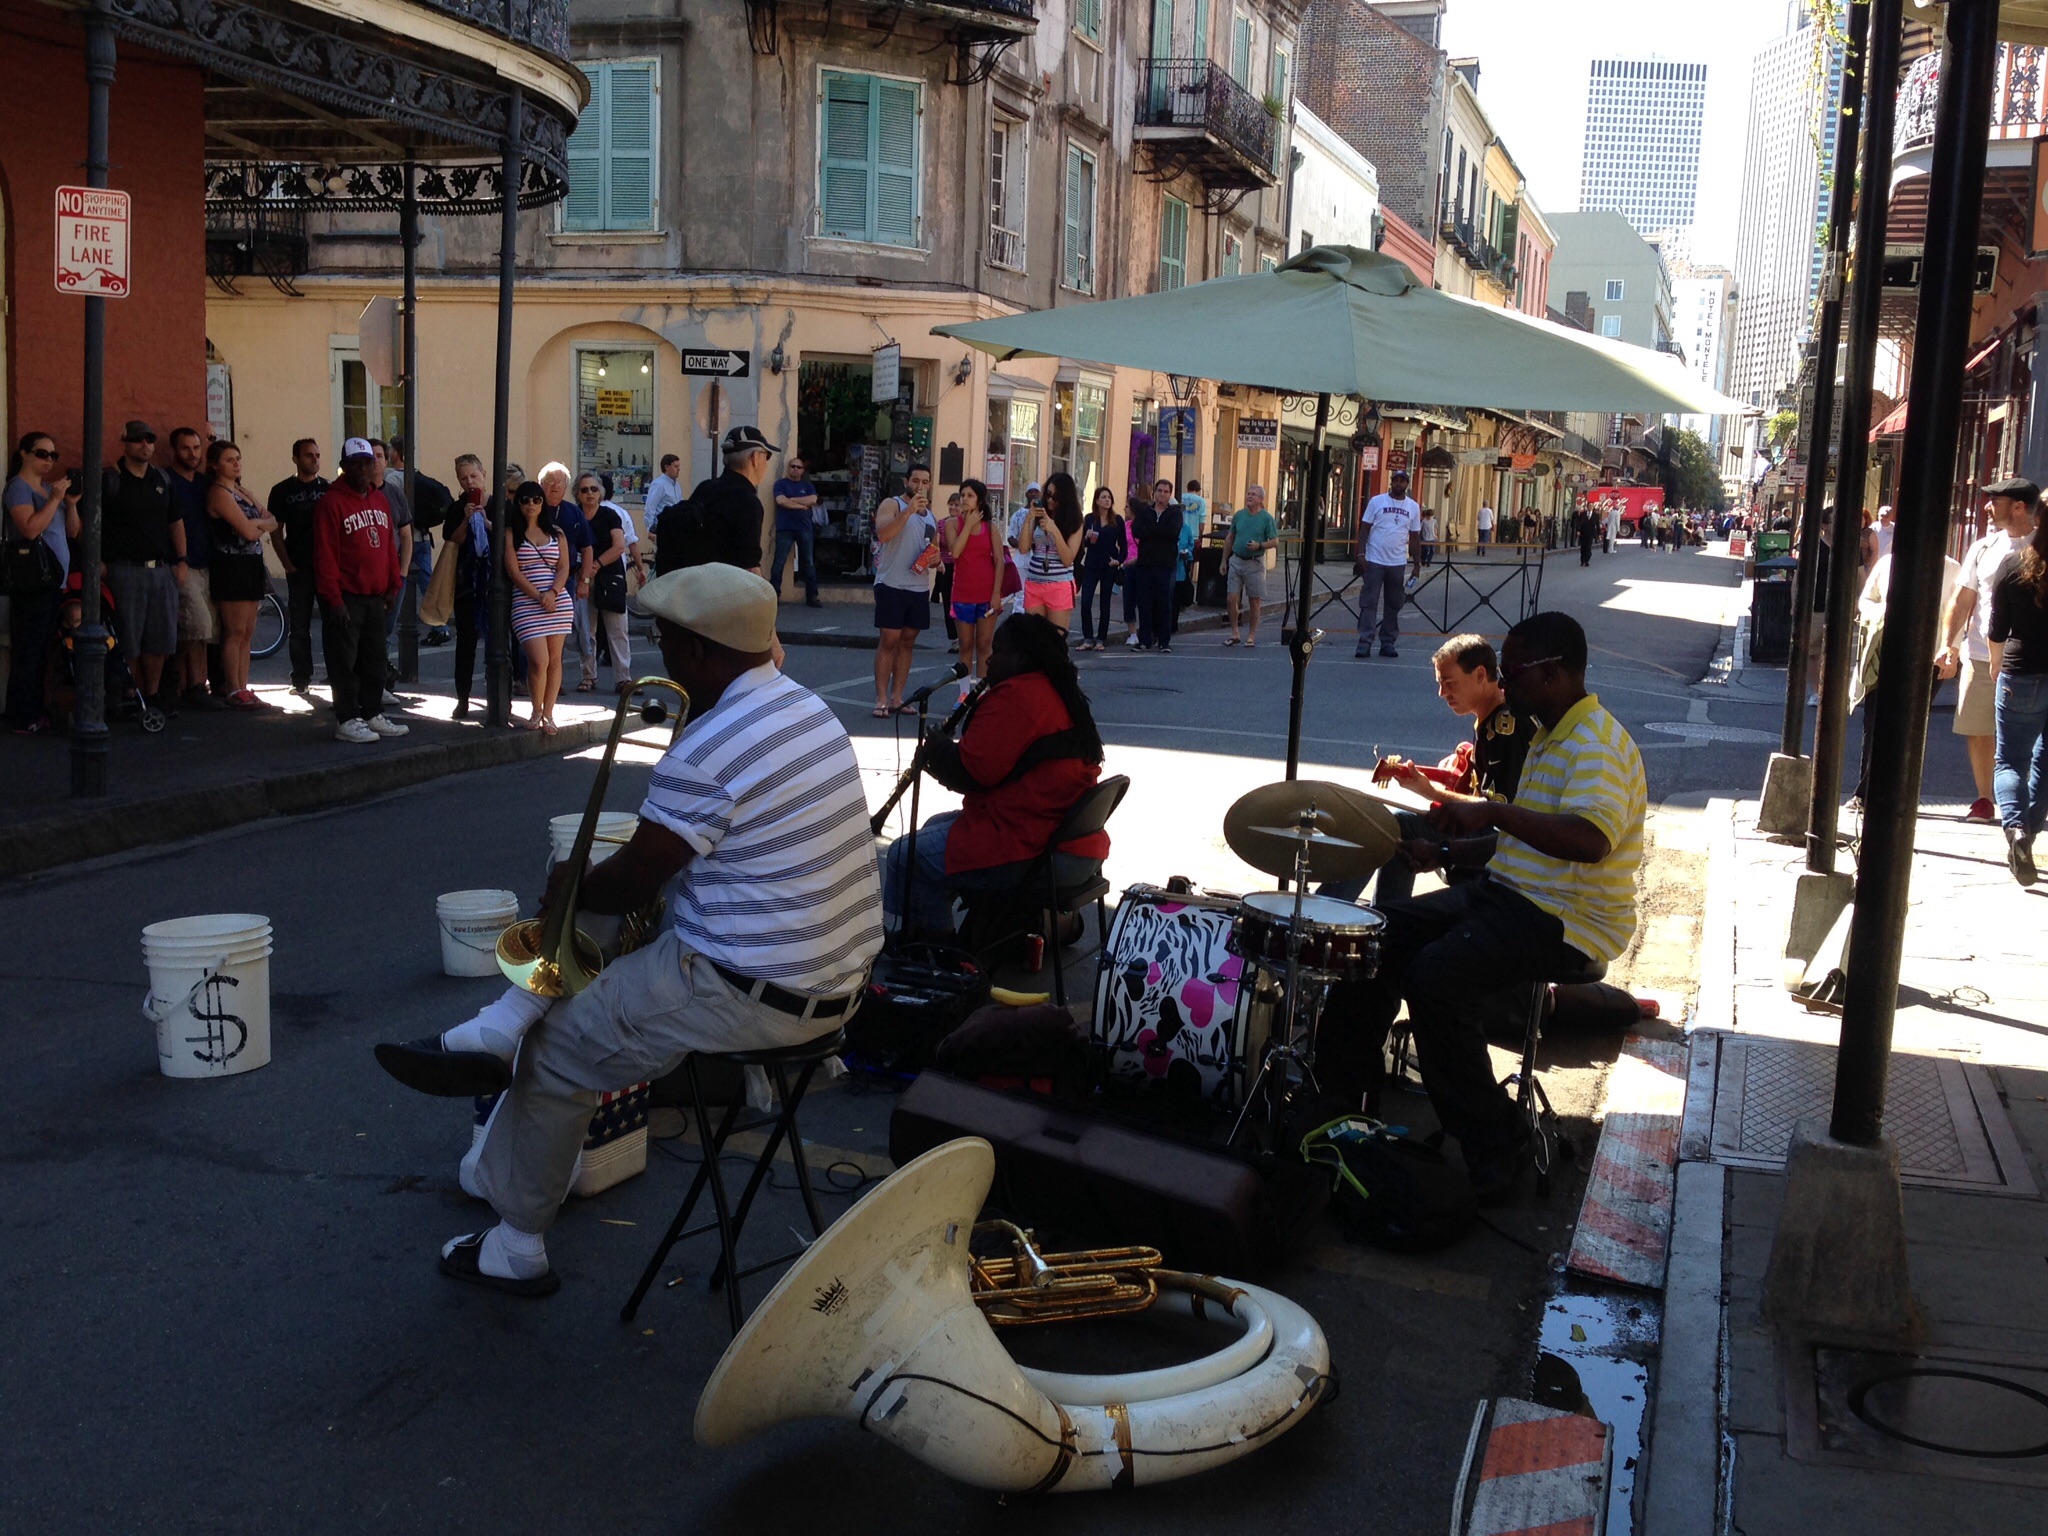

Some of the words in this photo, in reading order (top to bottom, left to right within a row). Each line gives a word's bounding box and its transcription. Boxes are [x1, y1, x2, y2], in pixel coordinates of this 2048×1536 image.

[60, 192, 82, 213] NO
[84, 194, 126, 207] STOPPING
[86, 205, 122, 217] ANYTIME
[74, 223, 111, 243] FIRE
[71, 246, 114, 266] LANE
[1706, 290, 1716, 327] HOTEL
[688, 356, 708, 368] ONE
[710, 357, 730, 369] WAY
[343, 509, 389, 535] STANFORD
[823, 1289, 850, 1317] KING
